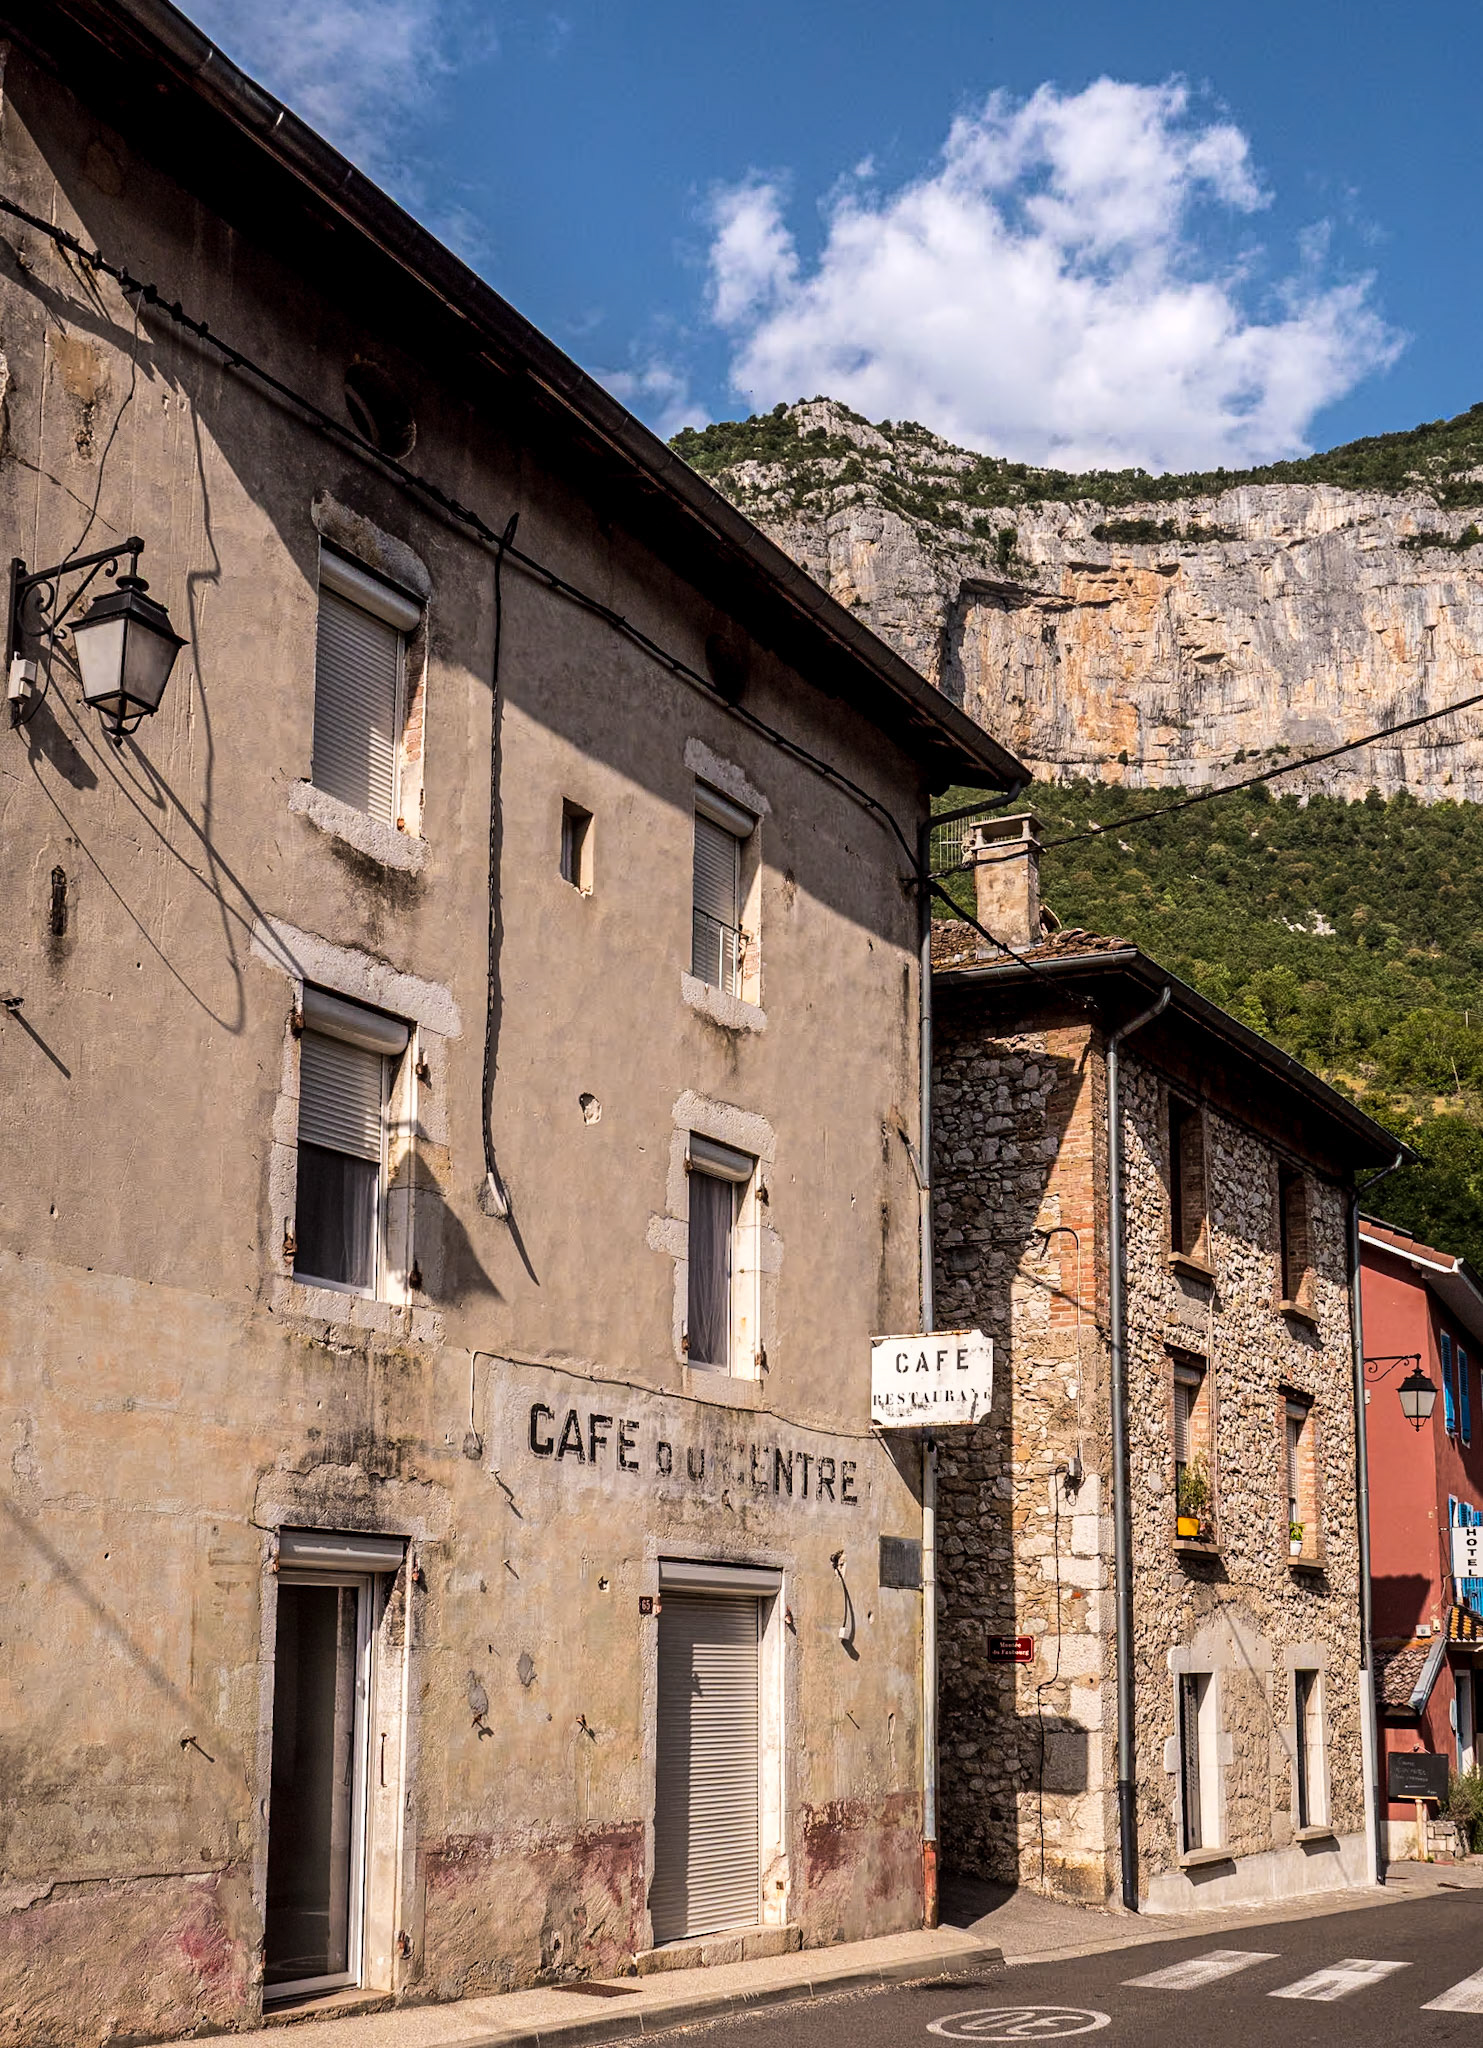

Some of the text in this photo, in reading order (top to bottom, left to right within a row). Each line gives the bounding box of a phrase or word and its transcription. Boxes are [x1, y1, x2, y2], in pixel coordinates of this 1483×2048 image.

[896, 1349, 969, 1373] CAFE
[873, 1387, 991, 1406] RESTAURA
[529, 1403, 640, 1473] CAFE
[656, 1440, 705, 1481] DU
[1466, 1528, 1478, 1577] HOTEL
[960, 2011, 1084, 2036] 30
